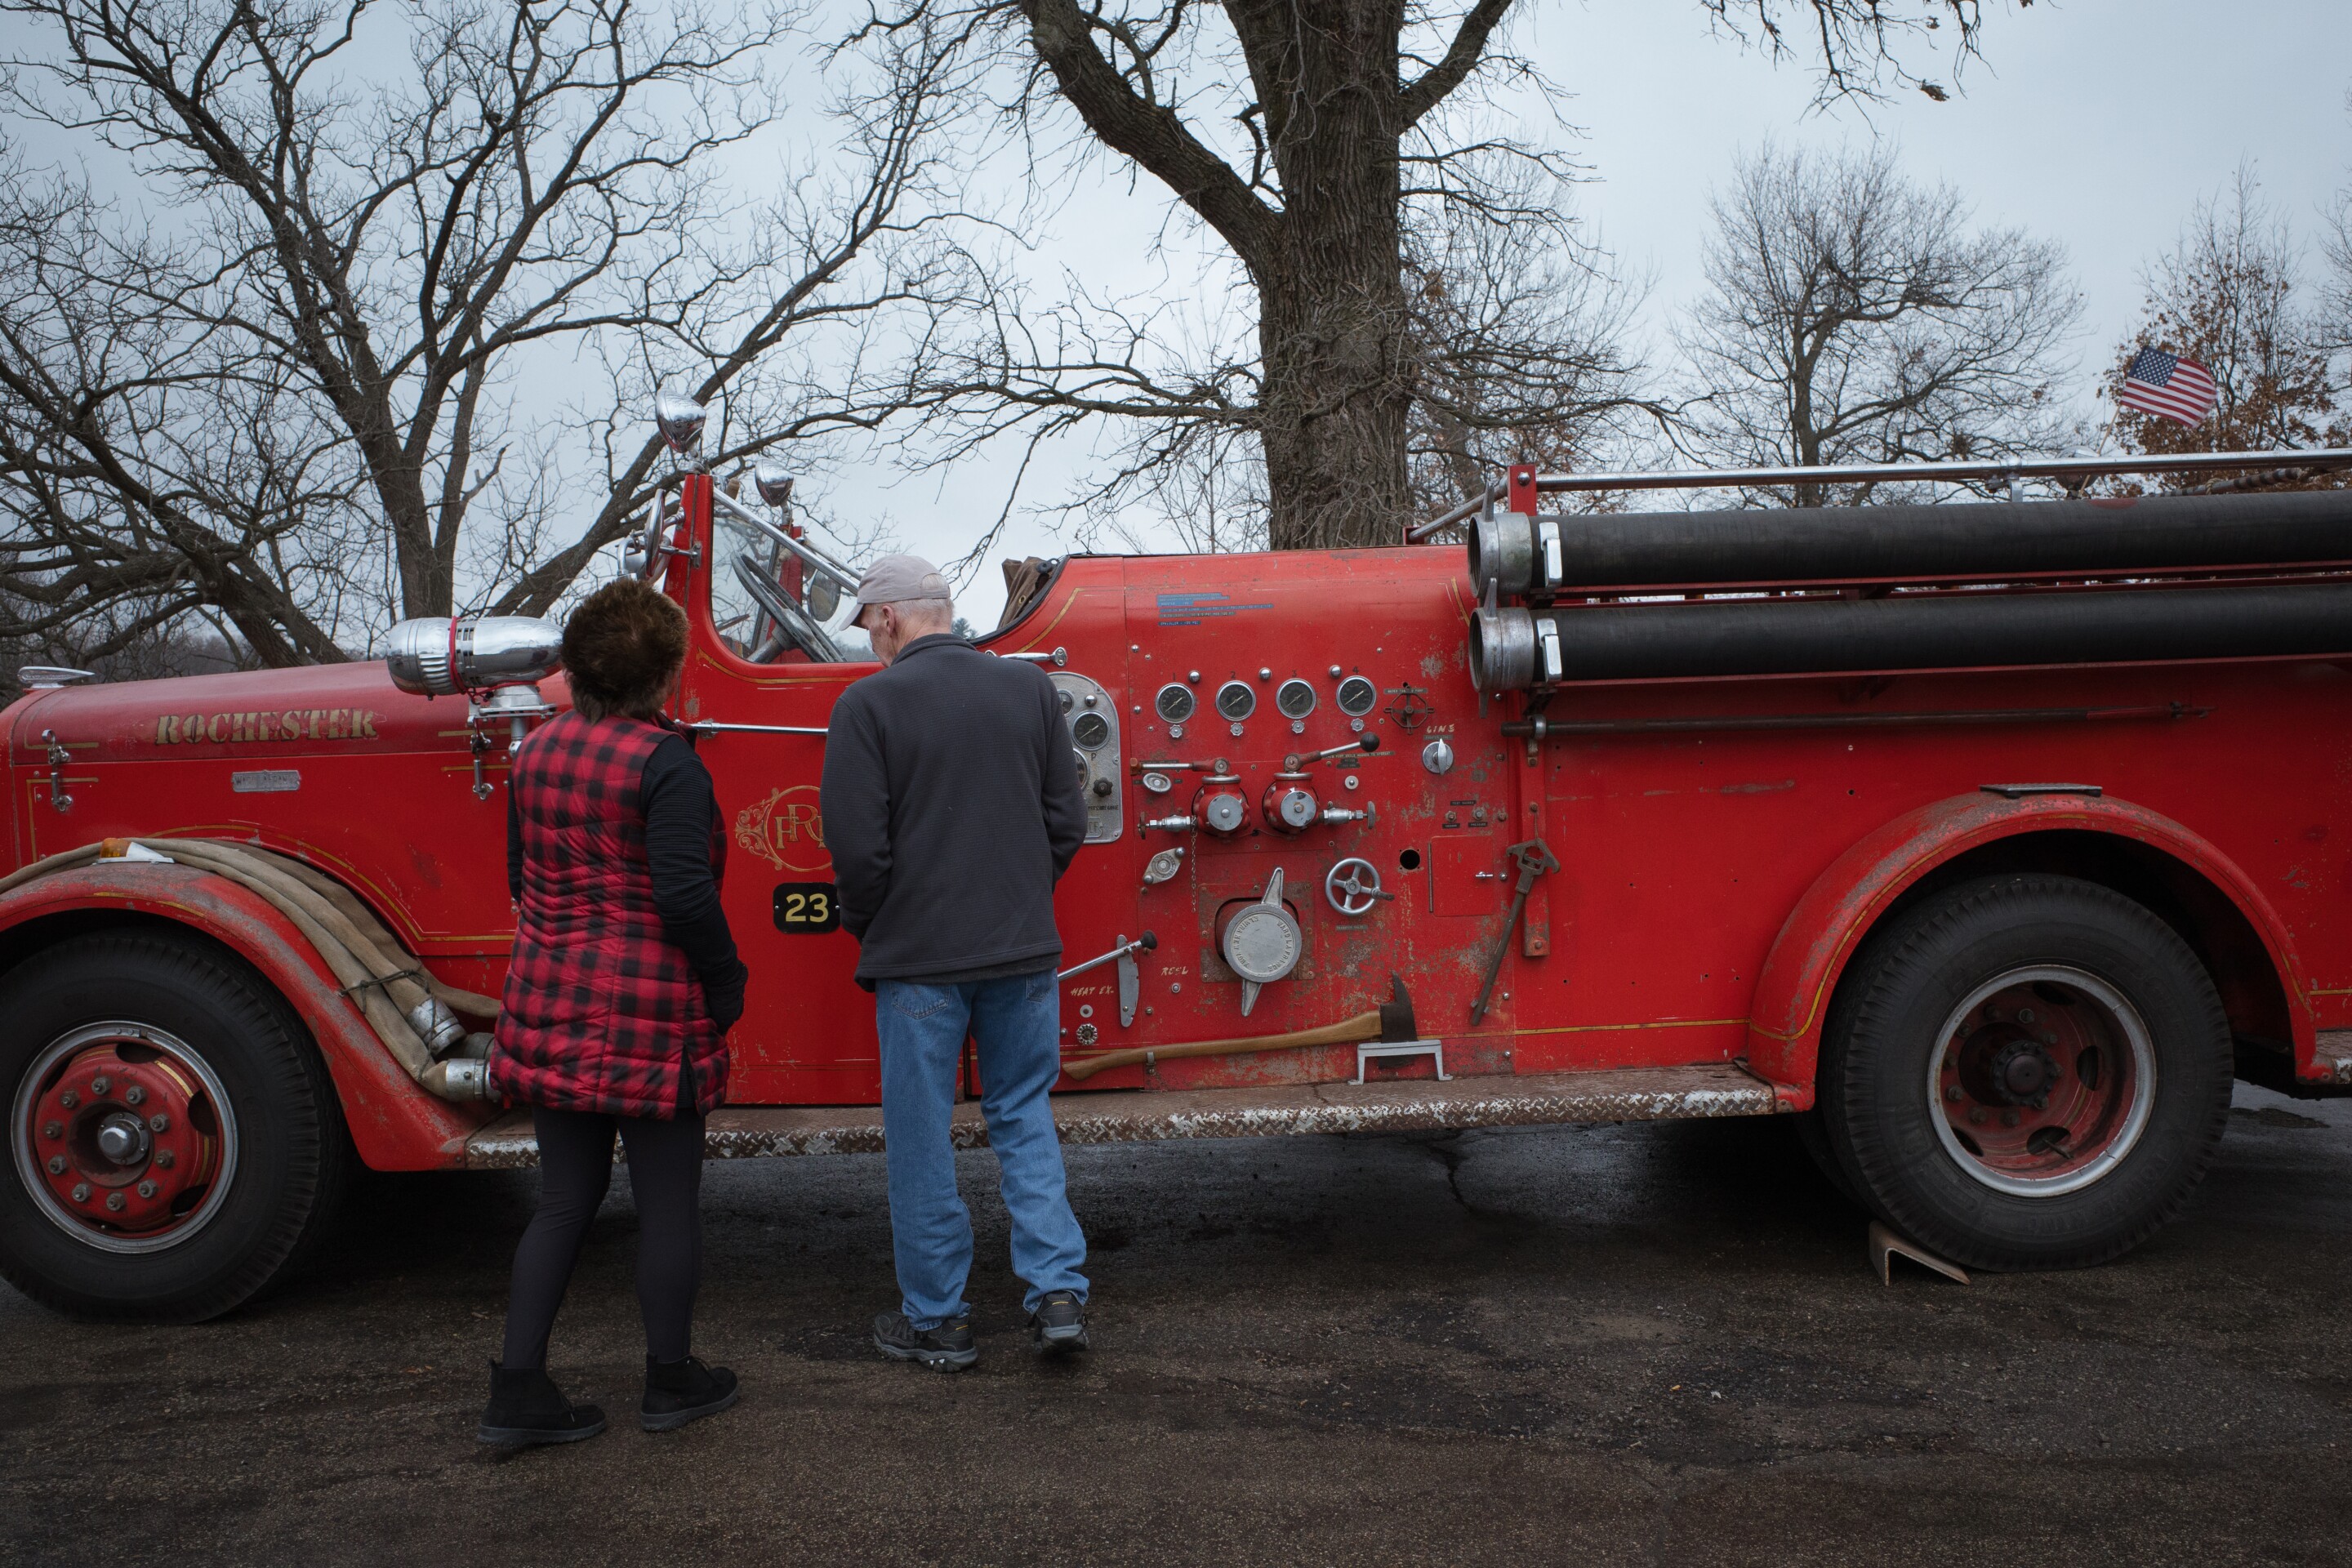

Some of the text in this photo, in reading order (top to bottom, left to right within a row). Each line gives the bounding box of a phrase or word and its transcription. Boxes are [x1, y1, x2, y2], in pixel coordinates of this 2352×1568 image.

[1292, 670, 1297, 678] 3
[1352, 666, 1359, 675] 4
[155, 708, 377, 745] ROCHESTER
[1090, 752, 1097, 762] P
[785, 893, 829, 923] 23
[1276, 920, 1291, 938] WARD
